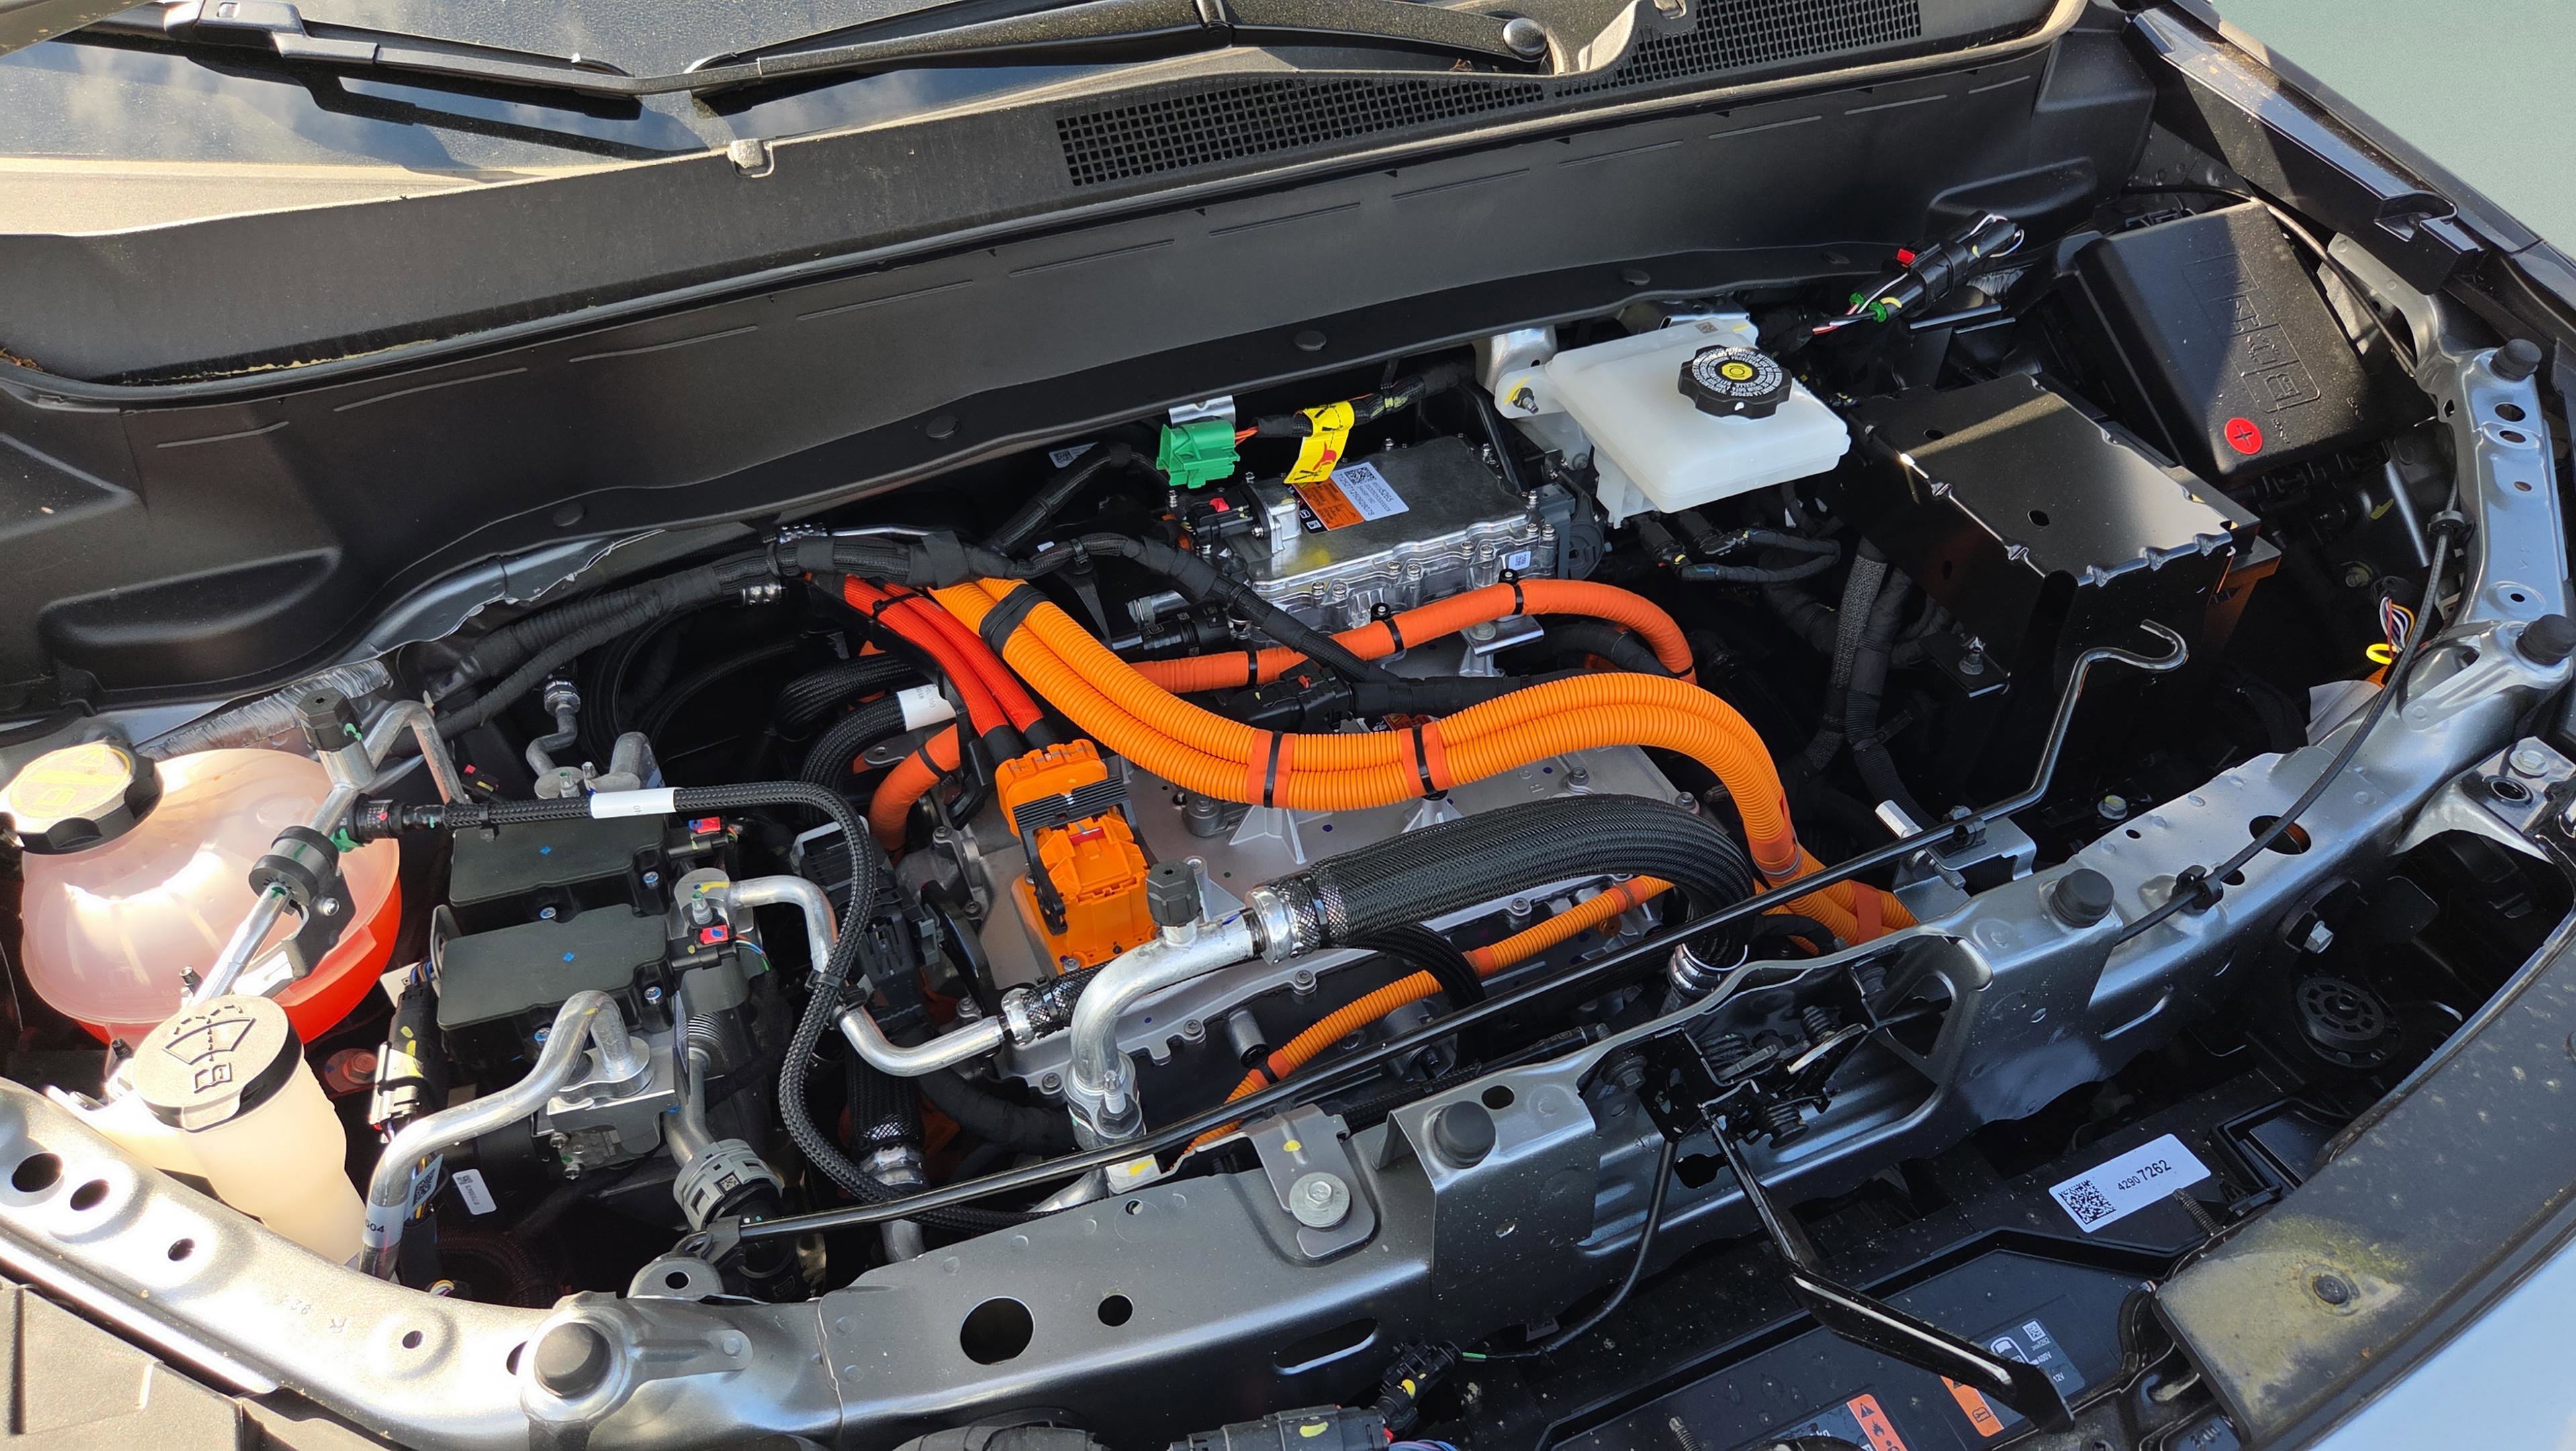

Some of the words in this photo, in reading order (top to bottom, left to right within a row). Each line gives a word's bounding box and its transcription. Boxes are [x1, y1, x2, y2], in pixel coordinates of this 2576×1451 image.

[2117, 1176, 2141, 1190] 4290
[2136, 1159, 2172, 1181] 7262
[2052, 1372, 2065, 1382] 12V
